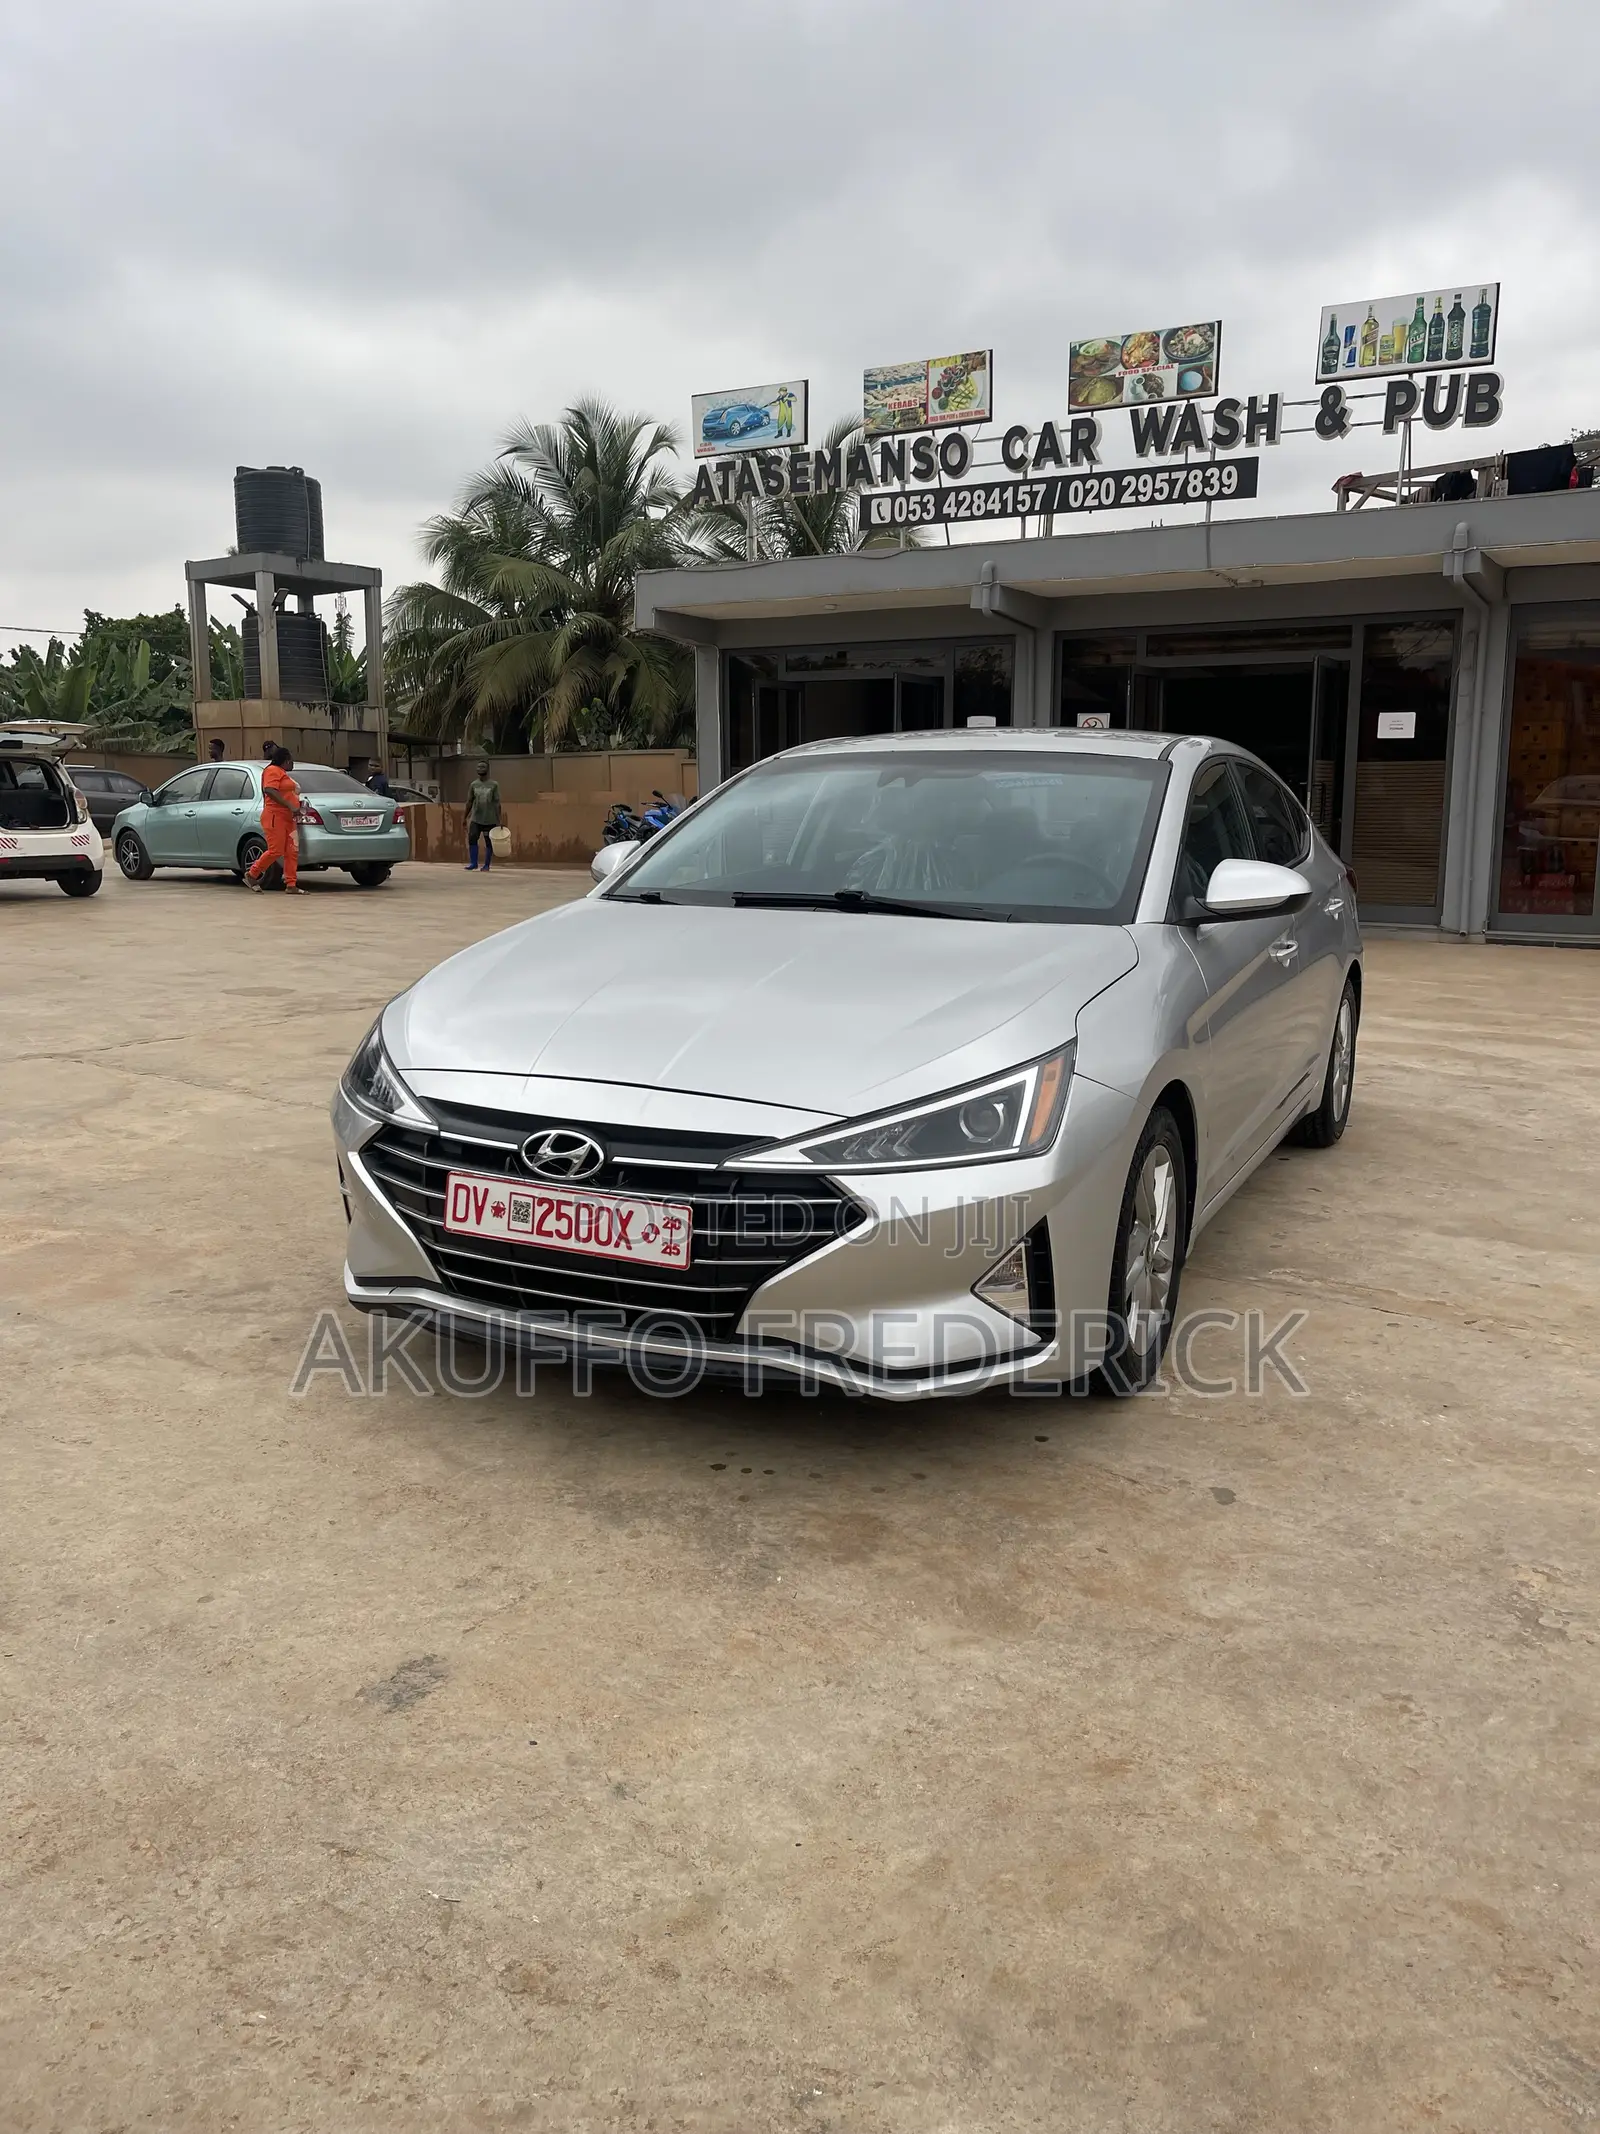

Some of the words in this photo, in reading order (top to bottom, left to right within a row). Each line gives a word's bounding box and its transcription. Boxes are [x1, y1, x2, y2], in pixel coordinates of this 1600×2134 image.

[1141, 364, 1175, 373] SPECIAL
[888, 399, 918, 410] KEBABS
[694, 431, 973, 508] ATASEMANSO
[1002, 416, 1102, 473] CAR
[1130, 392, 1284, 457] WASH
[1314, 385, 1353, 441] &
[1382, 371, 1504, 435] PUB
[893, 494, 936, 523] 053
[941, 484, 1047, 519] 4284157
[1069, 477, 1115, 509] 020
[1120, 466, 1239, 503] 2957839
[452, 1183, 489, 1225] DV
[536, 1197, 633, 1250] 2500X
